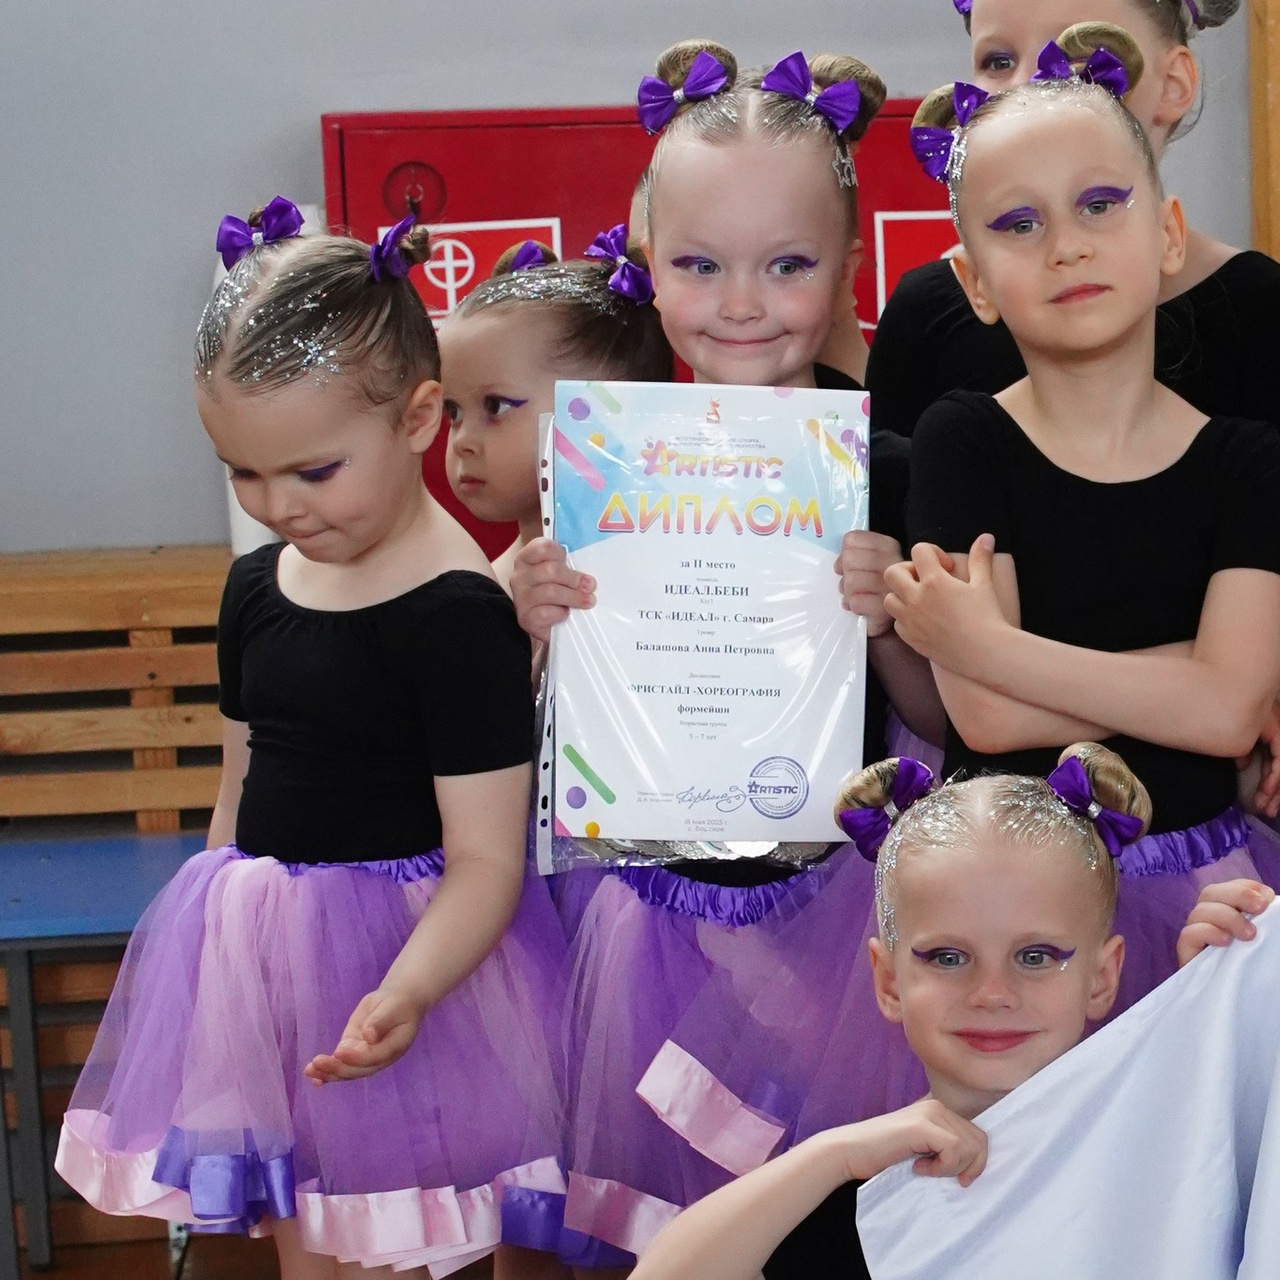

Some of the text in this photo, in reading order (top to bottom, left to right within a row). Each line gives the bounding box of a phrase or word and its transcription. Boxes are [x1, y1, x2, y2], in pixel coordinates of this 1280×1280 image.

[640, 439, 784, 479] ARTISTIC
[597, 491, 824, 537] ДИПЛОМ
[694, 559, 702, 568] II
[706, 561, 736, 570] место
[664, 584, 749, 596] ИДЕАЛ.БЕБИ
[638, 610, 663, 620] ТСК
[665, 611, 720, 622] «ИДЕАЛ»
[734, 613, 774, 624] Самара
[635, 641, 775, 656] Балашова Анна Петровна
[747, 780, 798, 794] ARTISTIC
